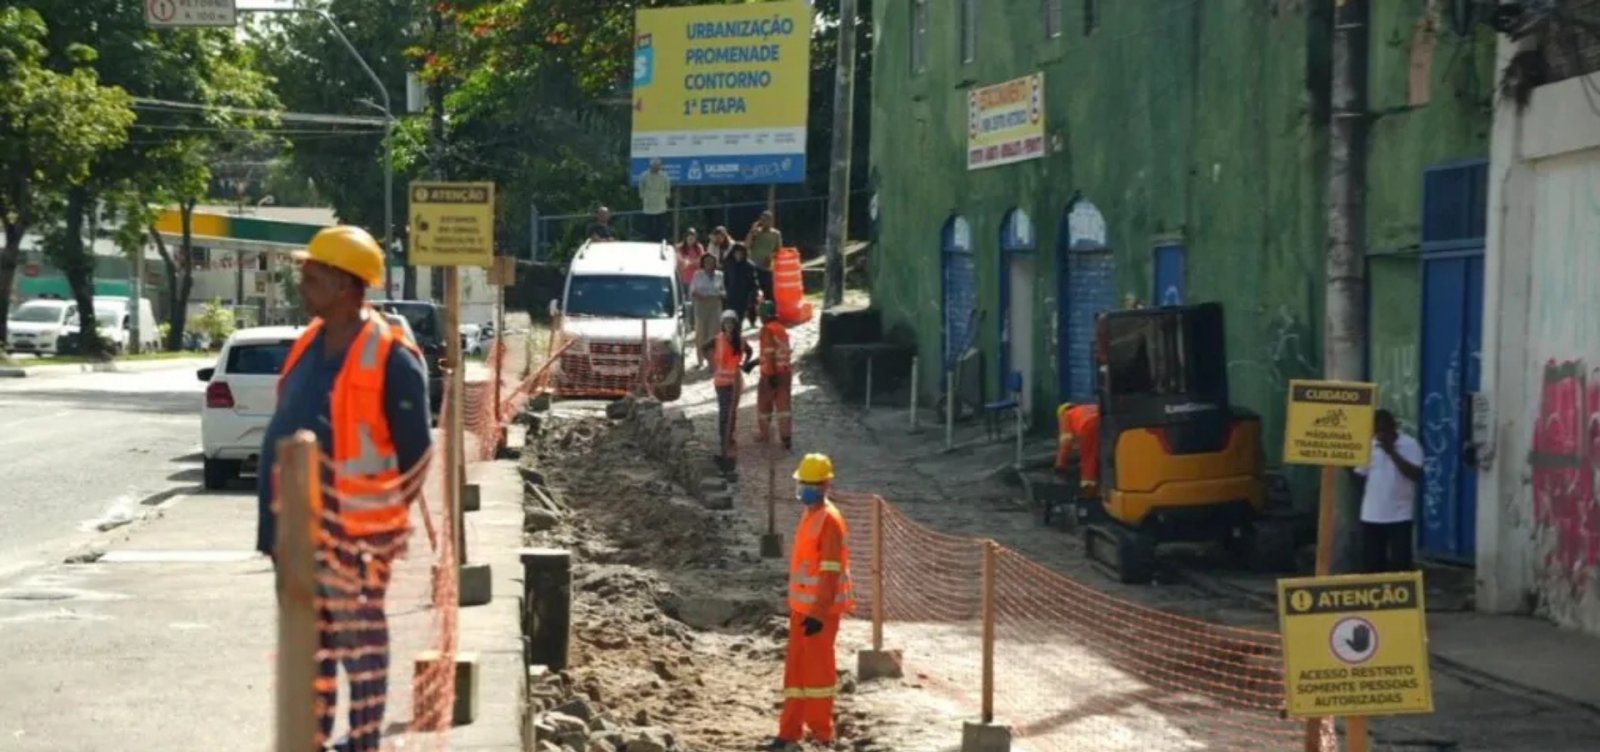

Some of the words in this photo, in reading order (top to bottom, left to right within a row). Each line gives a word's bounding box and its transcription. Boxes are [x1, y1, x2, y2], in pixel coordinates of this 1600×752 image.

[686, 15, 794, 40] URBANIZAÇÃO
[685, 45, 780, 65] PROMENADE
[684, 71, 771, 90] CONTORNO
[701, 98, 746, 114] ETAPA
[430, 188, 484, 201] ATENÇÃO
[1305, 389, 1360, 401] CUIDADO
[1294, 439, 1363, 452] TRABALHANDO
[1318, 583, 1409, 607] ATENÇÃO
[1299, 668, 1348, 680] ACESSO
[1351, 665, 1415, 678] RESTRITO
[1297, 681, 1356, 694] SOMENTE
[1360, 677, 1418, 691] PESSOAS
[1315, 693, 1403, 707] AUTORIZADAS
